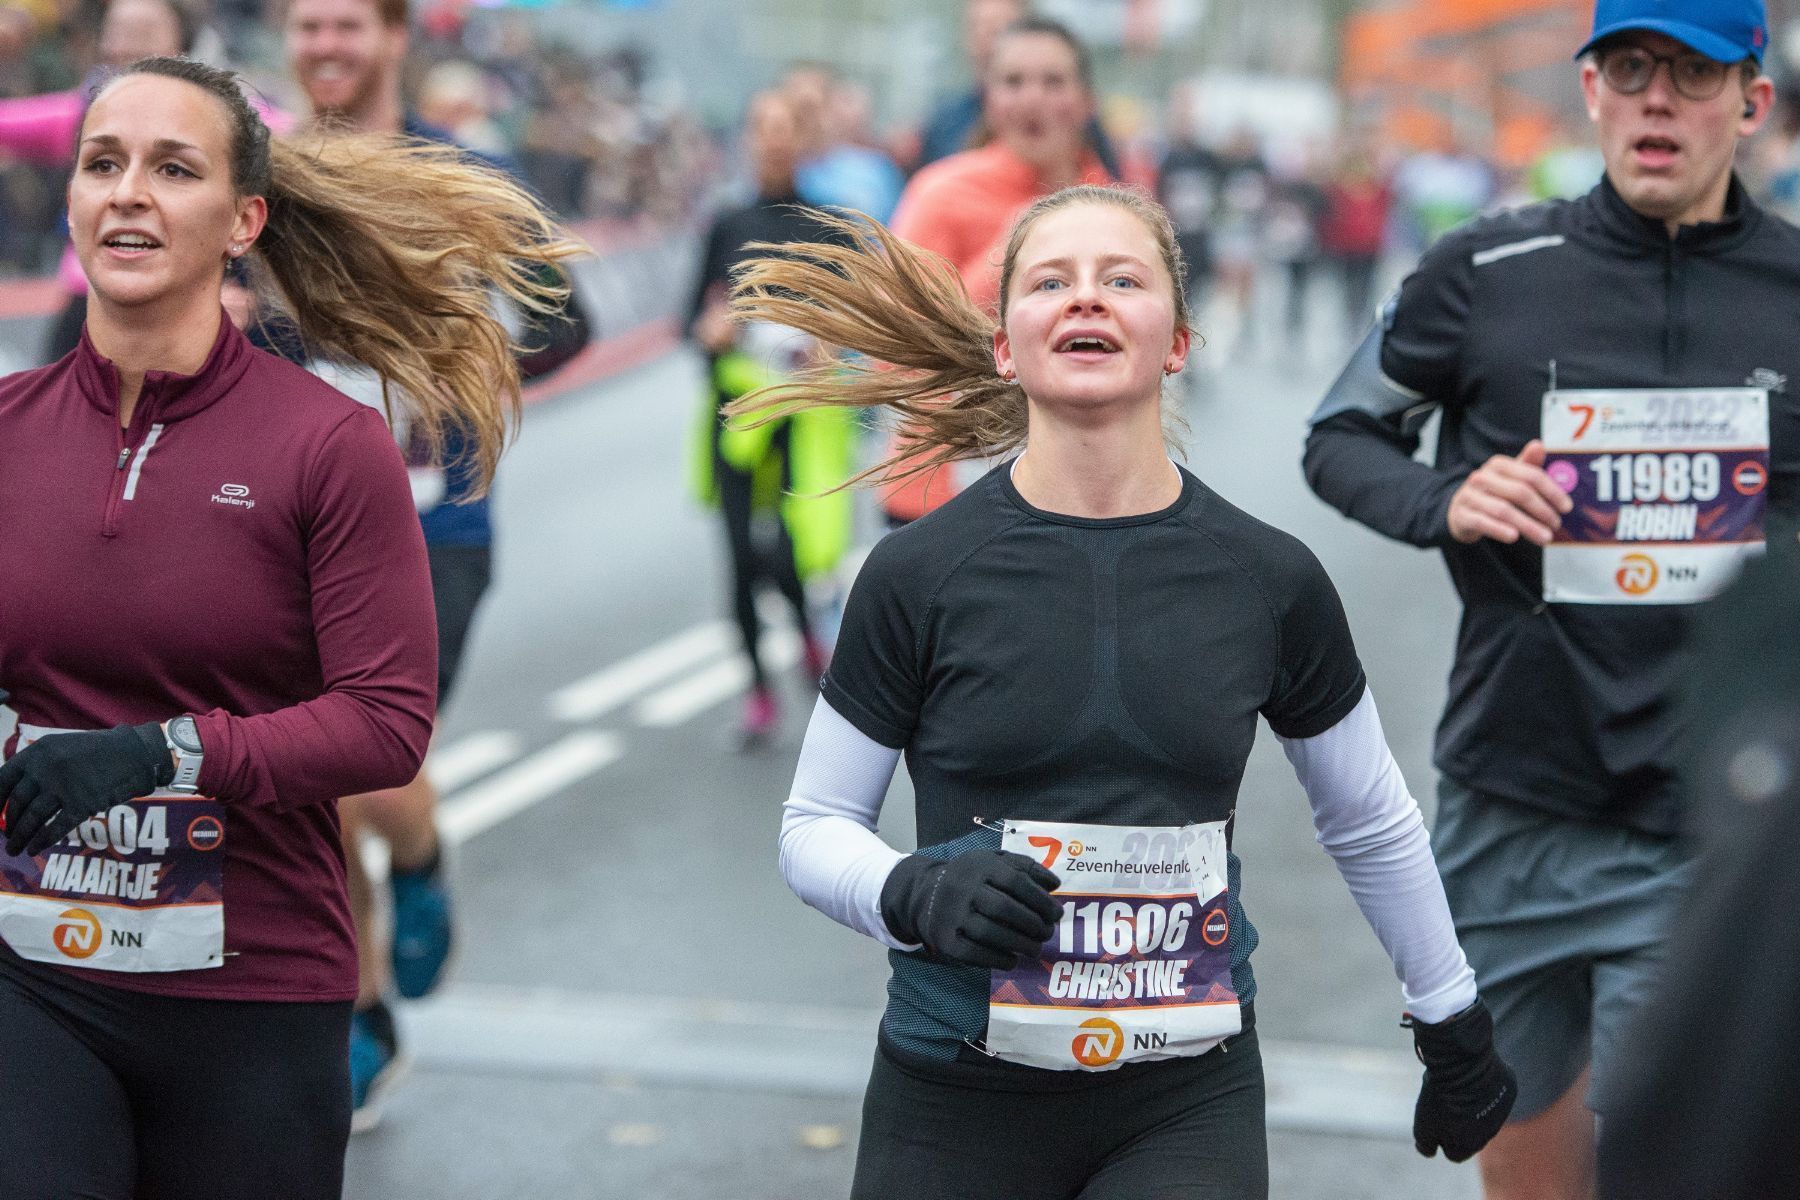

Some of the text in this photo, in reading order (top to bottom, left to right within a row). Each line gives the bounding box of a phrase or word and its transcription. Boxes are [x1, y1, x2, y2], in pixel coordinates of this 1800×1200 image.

[1568, 403, 1595, 441] 7
[1589, 452, 1721, 502] 11989
[211, 494, 255, 509] Kalenji
[1615, 503, 1698, 541] ROBIN
[54, 805, 170, 855] 604
[1028, 836, 1062, 869] 7
[1066, 858, 1190, 875] Zevenheuvelenlo
[1112, 829, 1213, 889] 202
[40, 854, 162, 900] MAARTJE
[110, 929, 142, 948] NN
[1059, 901, 1193, 955] 11606
[1048, 959, 1188, 1000] CHRISTINE
[1133, 1032, 1168, 1051] NN
